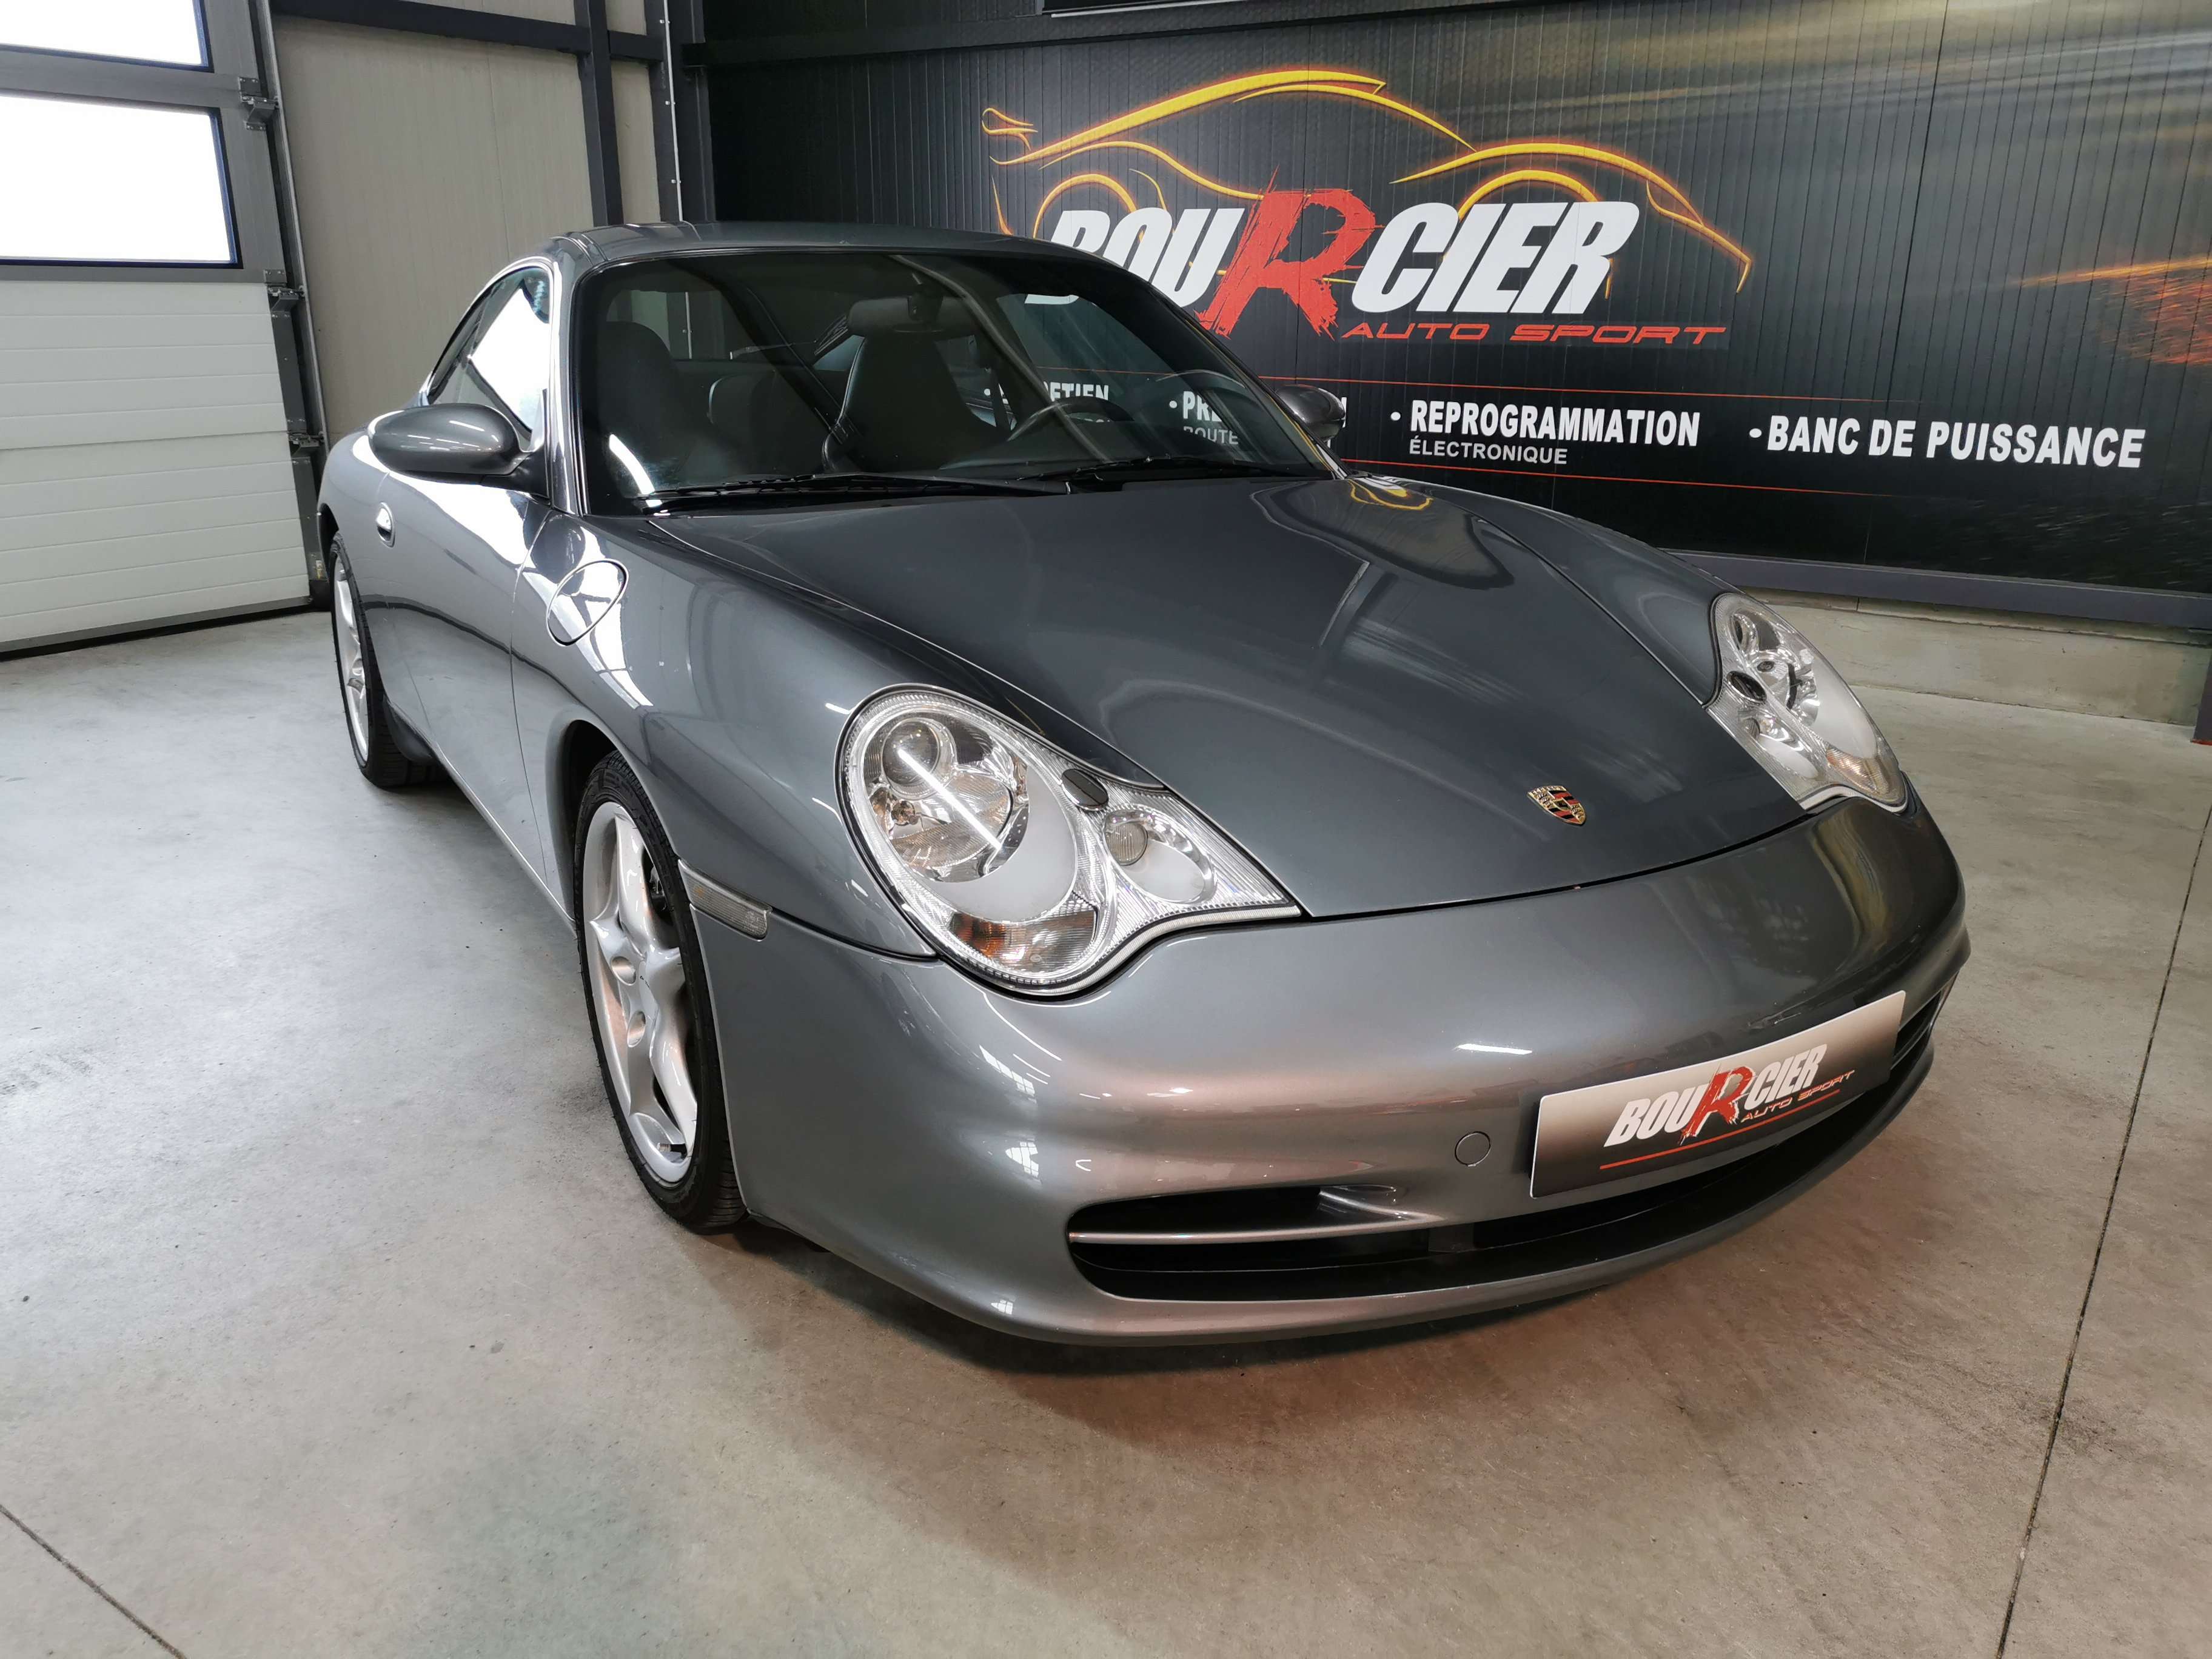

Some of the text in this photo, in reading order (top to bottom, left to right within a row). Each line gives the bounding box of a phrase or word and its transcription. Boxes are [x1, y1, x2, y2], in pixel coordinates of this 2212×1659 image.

[1342, 323, 1726, 344] AUTO SPORT
[1410, 400, 1700, 447] REPROGRAMMATION
[1767, 415, 2146, 468] BANC DE PUISSANCE
[1409, 438, 1568, 464] ÉLECTRONIQUE
[1604, 1044, 1828, 1147] BOURCIER
[1741, 1069, 1855, 1123] AUTO SPORT
